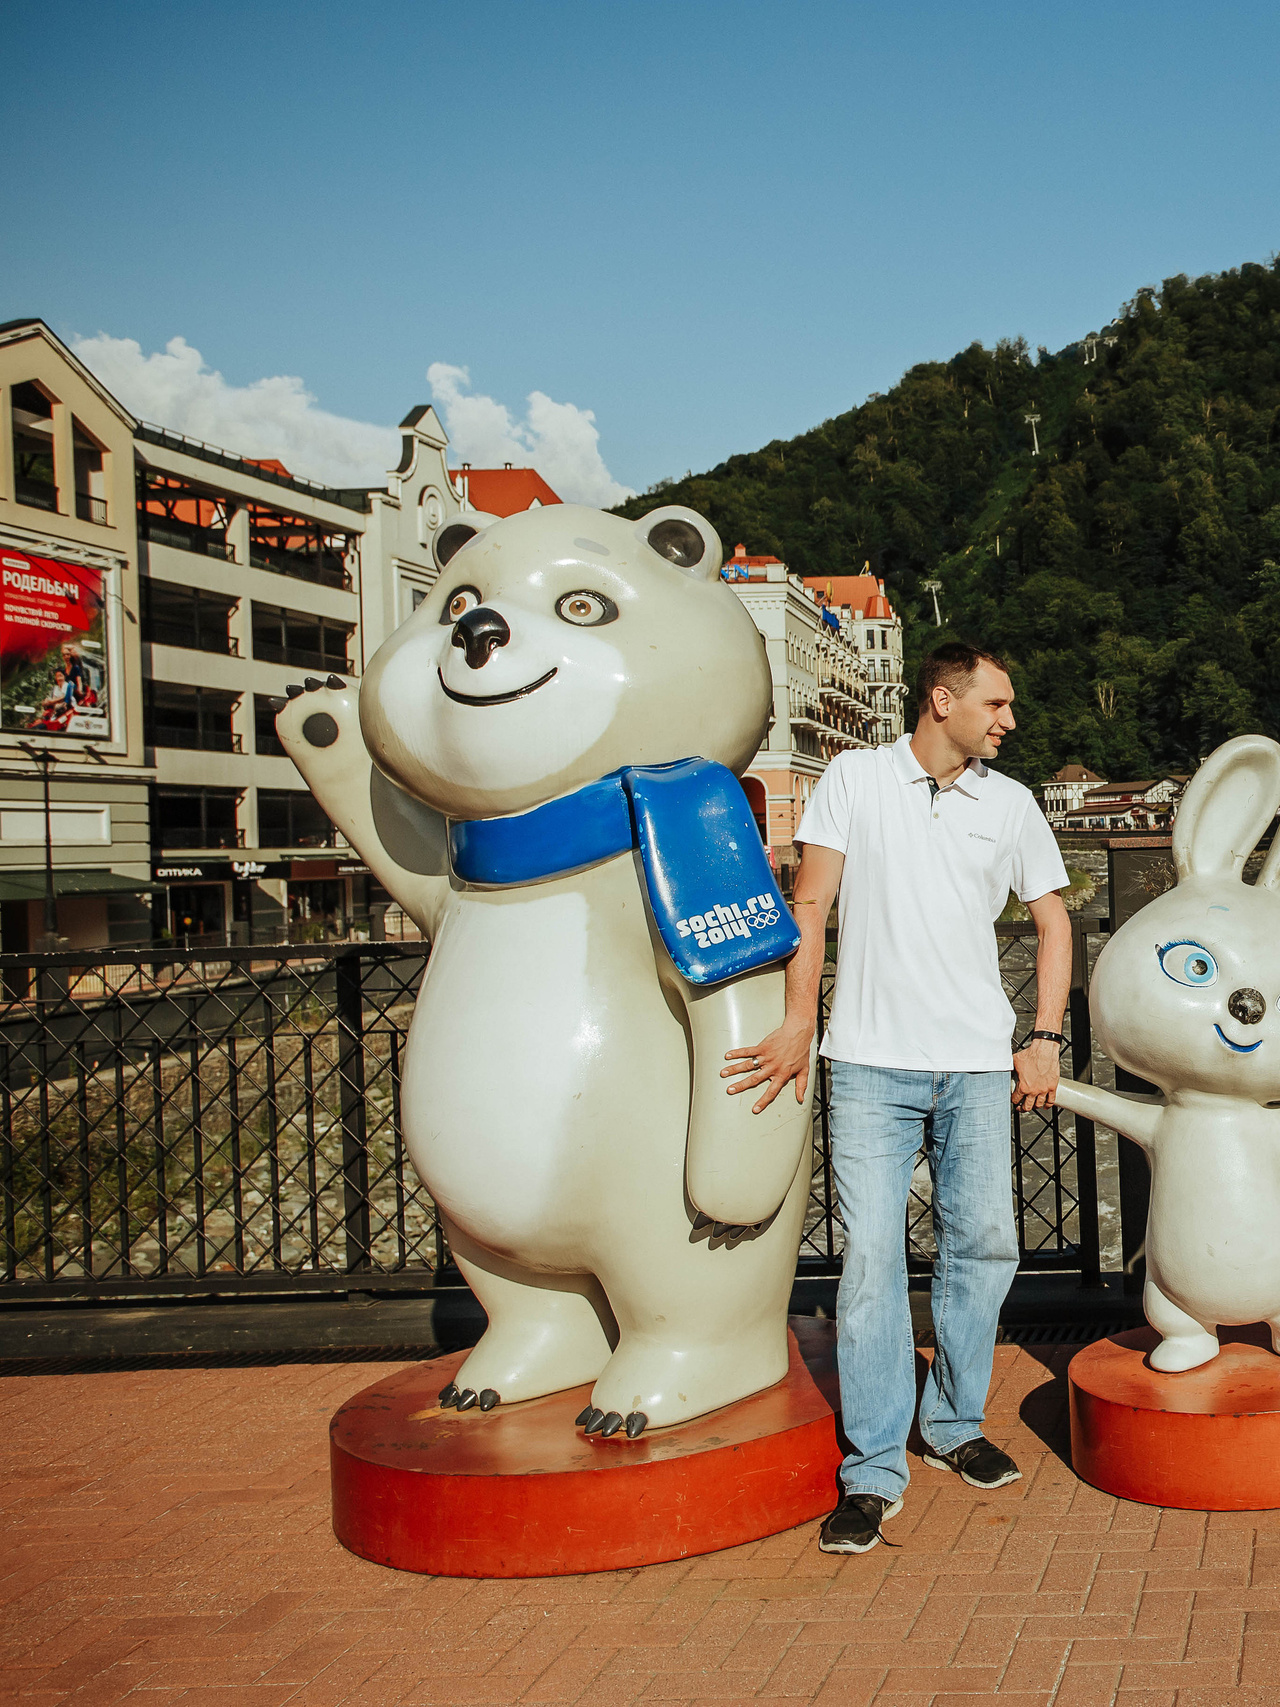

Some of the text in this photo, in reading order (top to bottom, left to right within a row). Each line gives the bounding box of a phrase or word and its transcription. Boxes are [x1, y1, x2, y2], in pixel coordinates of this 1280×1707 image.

[156, 868, 203, 877] ОПТИКА
[675, 892, 776, 938] sochi.ru
[694, 918, 752, 949] 2014
